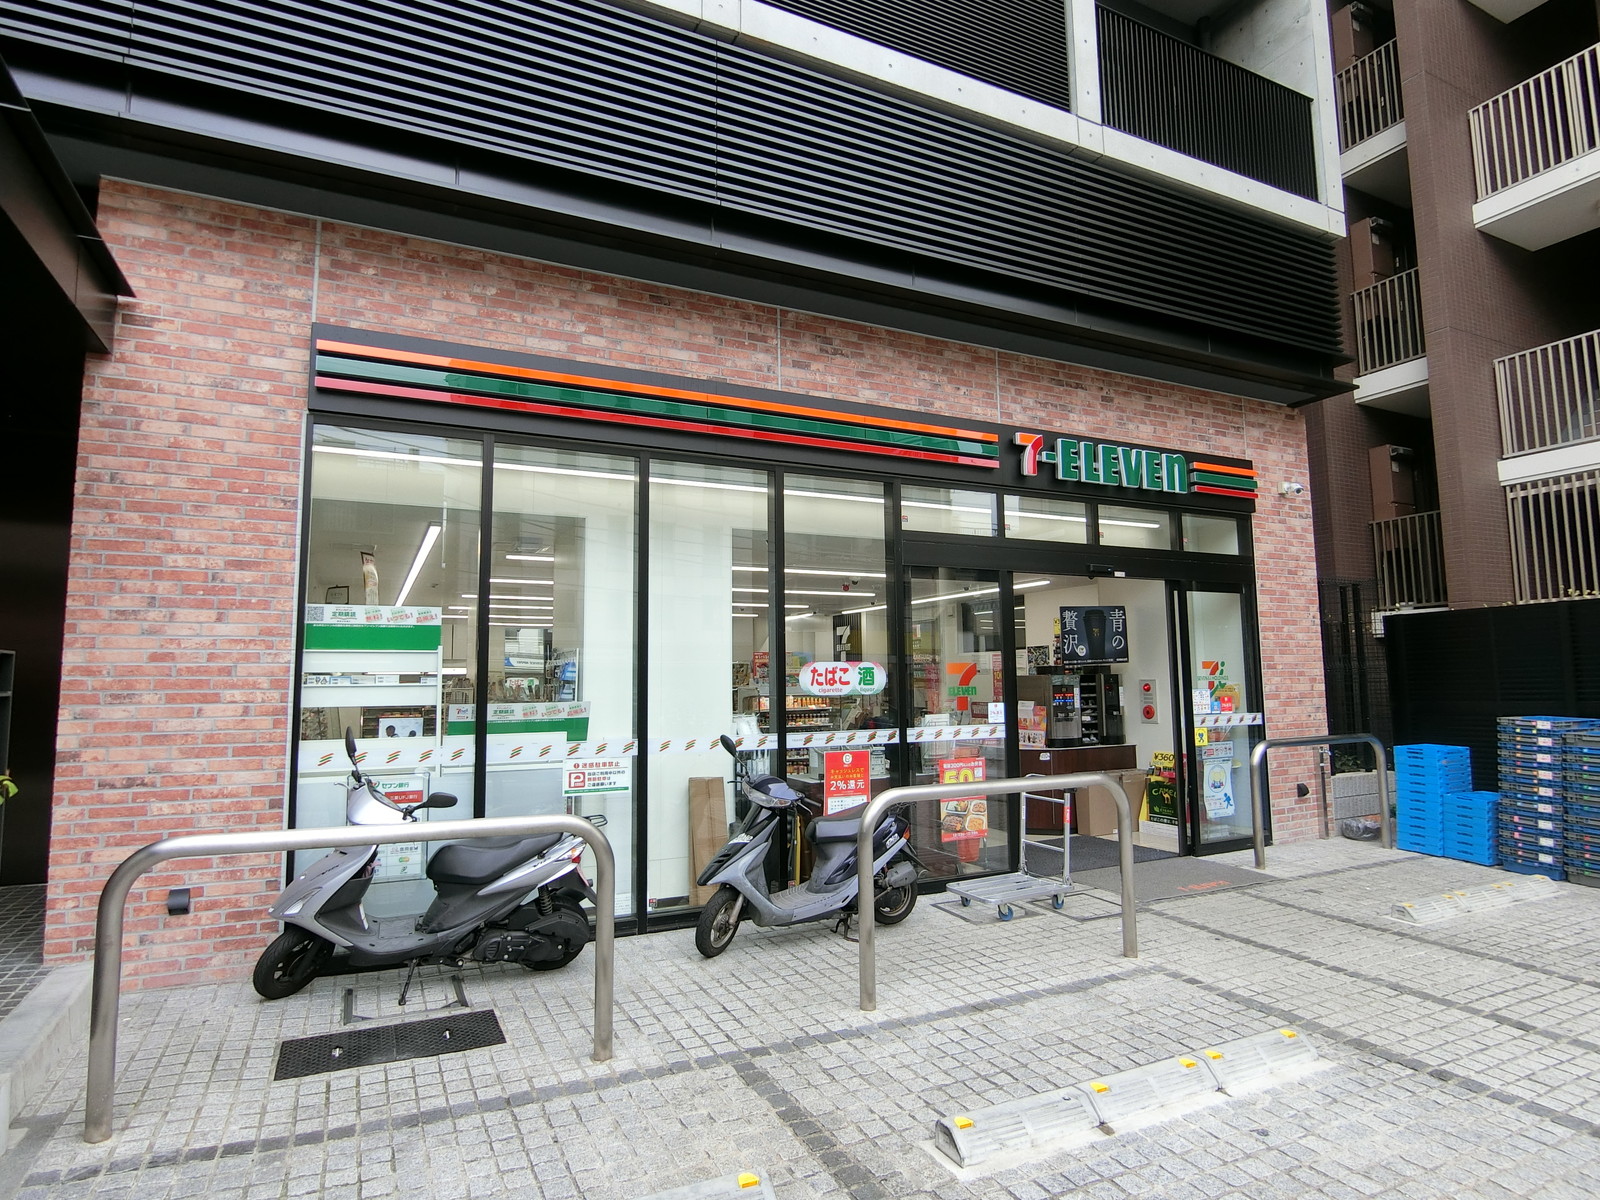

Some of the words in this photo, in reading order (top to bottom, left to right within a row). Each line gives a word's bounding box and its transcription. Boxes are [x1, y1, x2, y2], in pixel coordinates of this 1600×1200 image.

[810, 666, 851, 687] たばこ
[858, 666, 875, 686] 酒
[381, 781, 410, 789] セブン銀行
[830, 779, 865, 791] 2%還元
